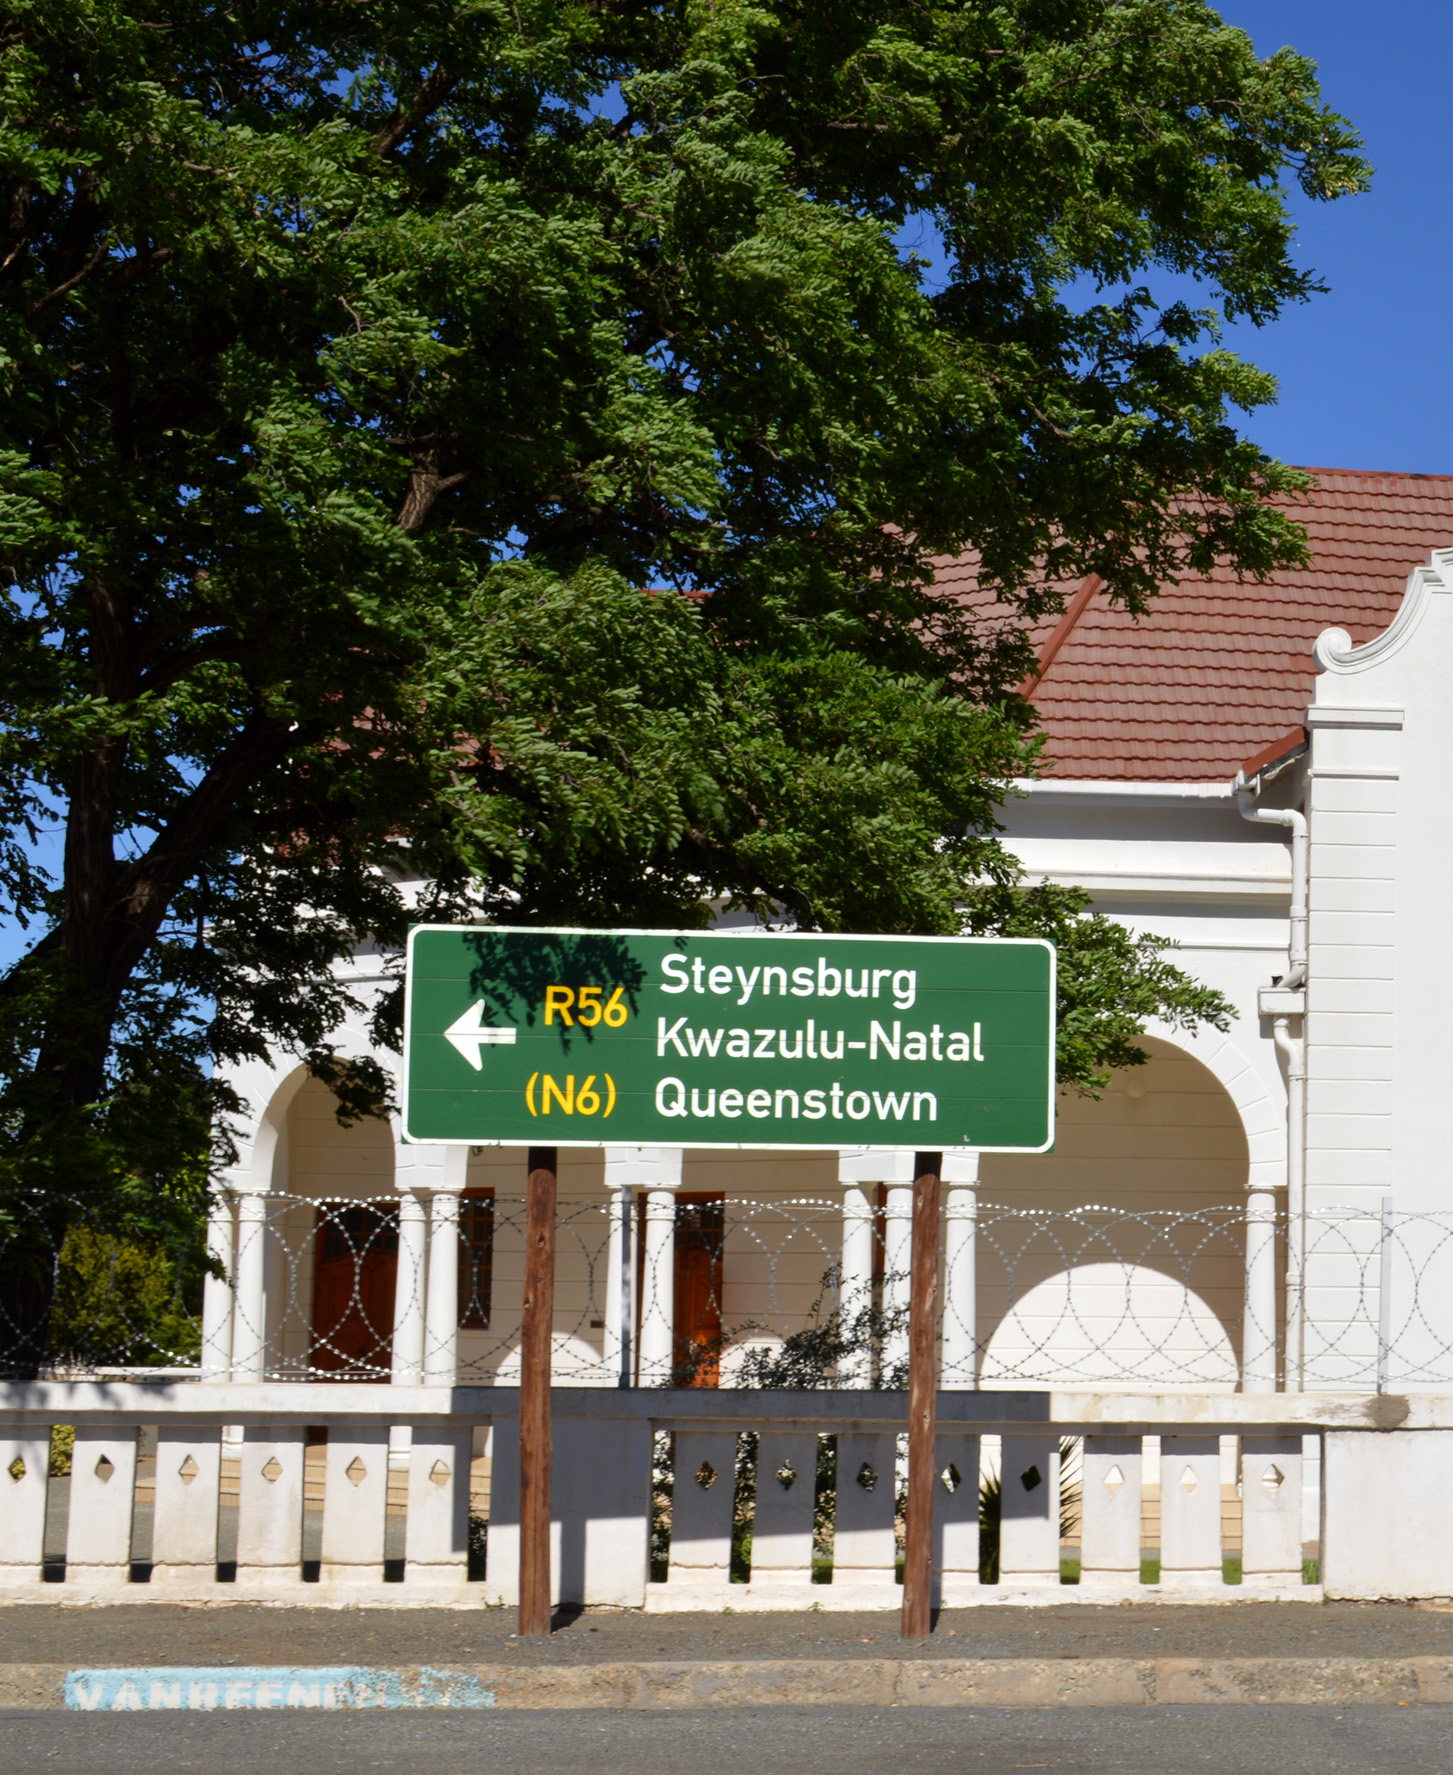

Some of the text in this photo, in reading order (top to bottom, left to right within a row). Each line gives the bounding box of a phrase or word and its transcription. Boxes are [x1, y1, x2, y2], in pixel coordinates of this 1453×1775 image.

[659, 953, 917, 1010] Steynsburg
[543, 985, 629, 1028] R56
[656, 1016, 985, 1062] Kwazulu-Natal
[525, 1071, 617, 1119] (N6)
[655, 1076, 937, 1121] Queenstown
